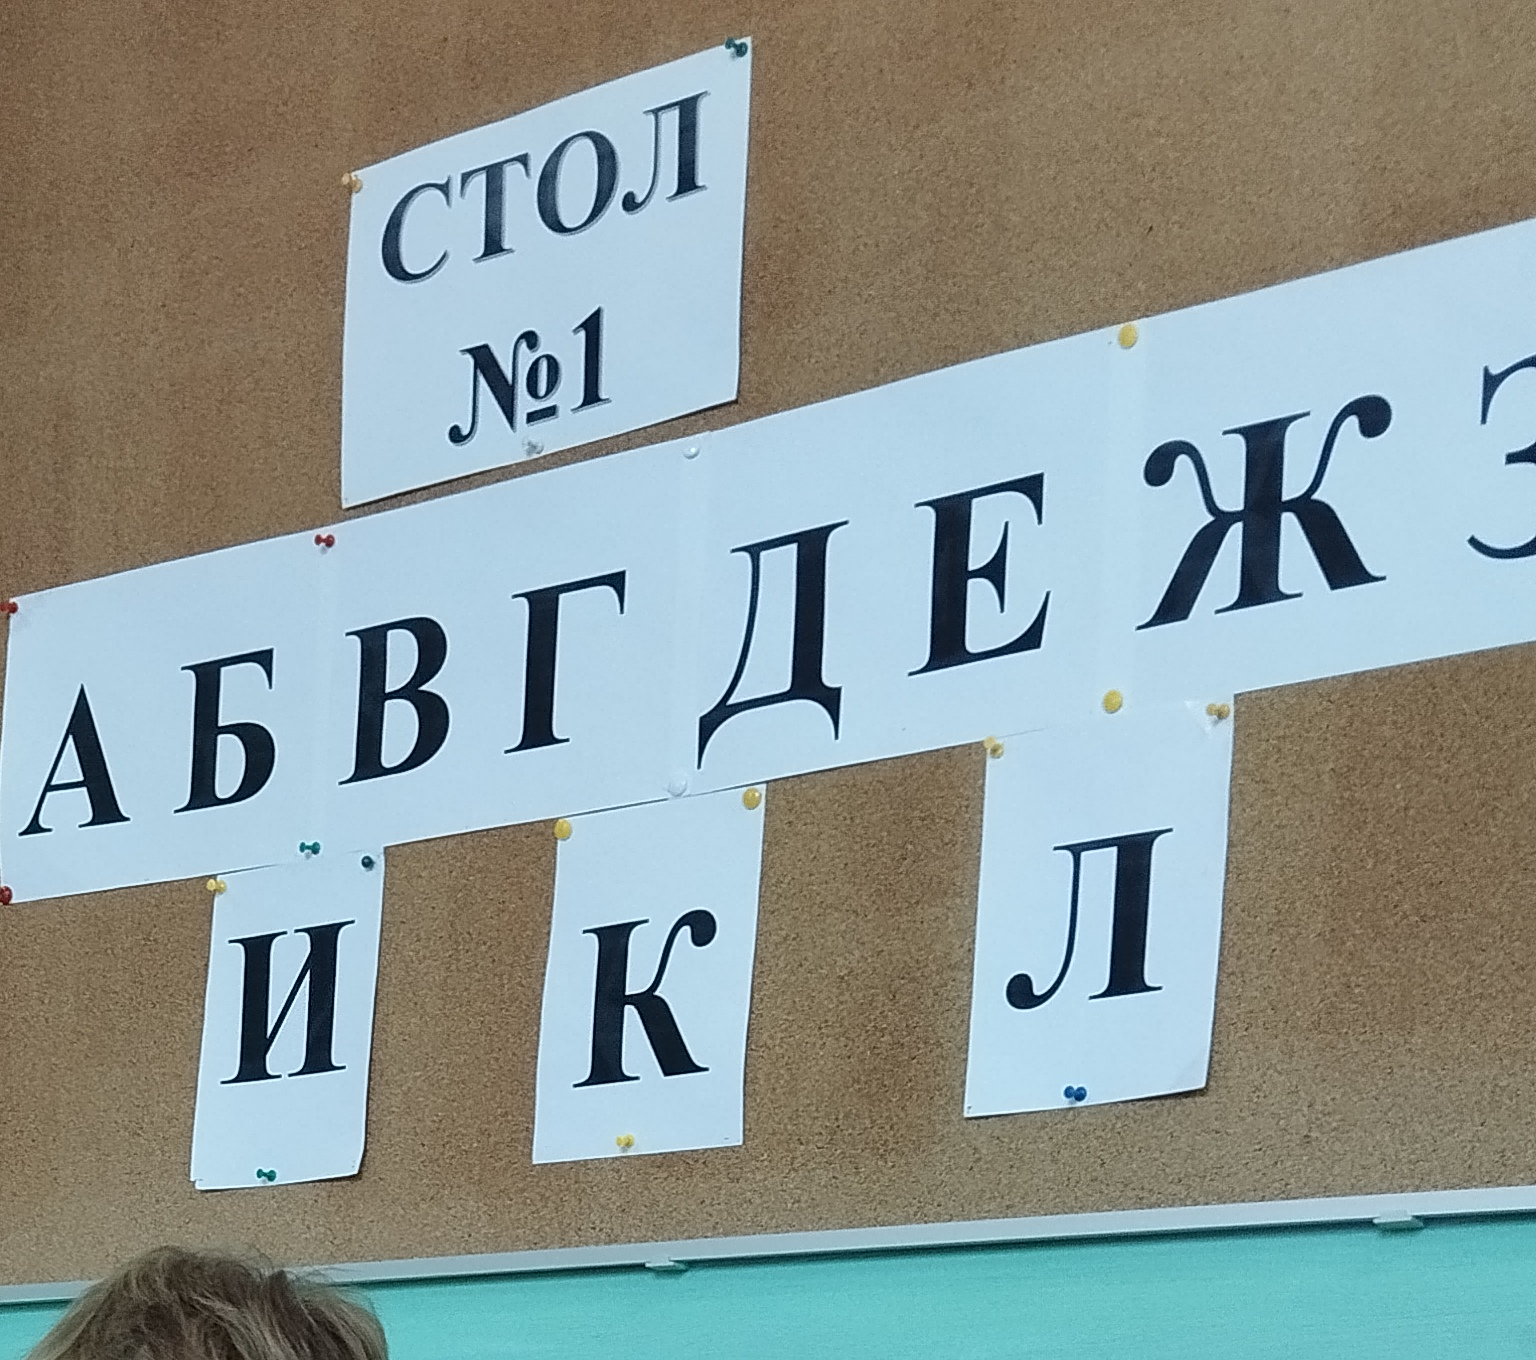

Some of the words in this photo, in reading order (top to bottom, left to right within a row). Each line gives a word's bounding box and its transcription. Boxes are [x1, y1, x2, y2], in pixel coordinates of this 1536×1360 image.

[378, 90, 710, 285] СТОЛ
[448, 305, 611, 445] №1
[219, 918, 357, 1086] И
[571, 908, 718, 1089] К
[1004, 826, 1174, 1011] Л
